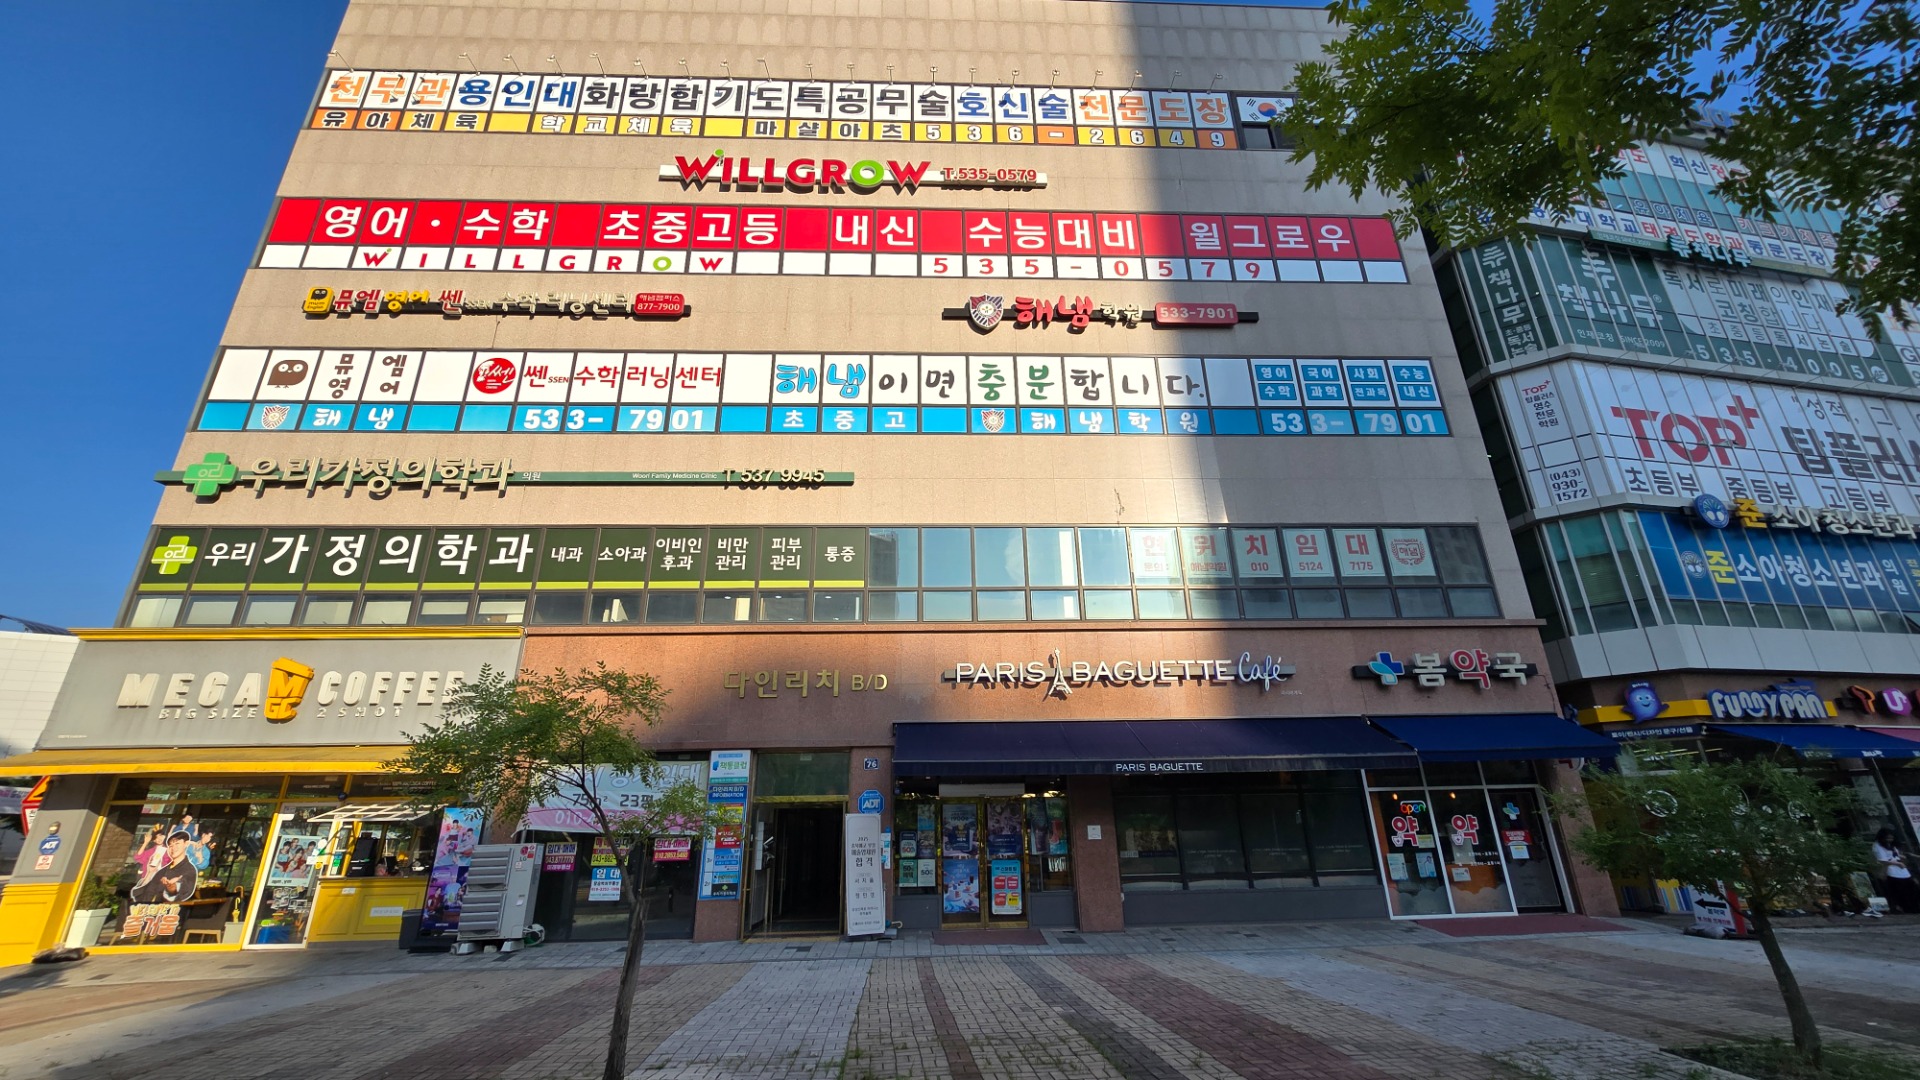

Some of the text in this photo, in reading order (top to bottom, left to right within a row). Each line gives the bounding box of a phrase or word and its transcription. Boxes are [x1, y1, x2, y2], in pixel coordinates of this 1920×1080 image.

[321, 111, 479, 130] 유아체육
[540, 113, 694, 135] 학교체육
[925, 125, 1226, 146] 536-2649
[674, 148, 1038, 187] WILLGROW T.535-0579
[603, 210, 779, 246] 초중고등
[835, 215, 914, 247] 내신
[969, 217, 1137, 250] 수능대비
[1190, 222, 1351, 252] 윌그로우
[932, 257, 1261, 279] 535-0579
[637, 303, 681, 312] 877-7900
[1014, 294, 1236, 328] 해냄 학원 533-7901
[1507, 331, 1535, 346] 독서
[523, 364, 549, 388] 쎈
[548, 375, 570, 384] SSEN
[1260, 366, 1425, 380] 영어 국어 사회 수능
[1263, 384, 1291, 398] 수학
[1310, 384, 1339, 398] 과학
[1402, 383, 1433, 398] 내신
[1524, 391, 1555, 404] 탑플러스
[1533, 400, 1552, 411] 영수
[312, 407, 395, 430] 해냄
[781, 409, 907, 432] 초중고
[1271, 411, 1436, 434] 533-7901
[1535, 409, 1556, 421] 전문
[1538, 417, 1559, 429] 학원
[240, 455, 542, 494] 우리가정의학과 의원
[651, 473, 672, 481] Family
[740, 467, 775, 483] 537
[779, 467, 826, 483] 9945
[1549, 467, 1581, 482] (043)
[1552, 479, 1584, 492] 930-
[1624, 466, 1892, 513] 초등부 중등부 고등부
[1555, 488, 1589, 502] 1572
[550, 537, 856, 564] 내과 소아과 이비인 비만 피부 통증
[660, 554, 801, 572] 후과 관리 관리
[1250, 562, 1270, 572] 010
[1298, 561, 1323, 572] 5124
[1349, 561, 1374, 571] 7175
[1704, 550, 1737, 584] 준
[956, 650, 1288, 692] PARIS BAGUETTE Café
[1412, 648, 1528, 690] 봄약국
[116, 671, 263, 707] MEGA
[723, 668, 889, 698] 다인리치 B/D
[158, 705, 404, 720] BIG SIZE 2 SHOT
[866, 760, 877, 768] 76
[1115, 762, 1204, 772] PARIS BAGUETTE
[863, 798, 881, 808] ADT
[1400, 802, 1427, 816] open
[855, 857, 873, 867] 합격
[123, 914, 181, 938] 즐거움
